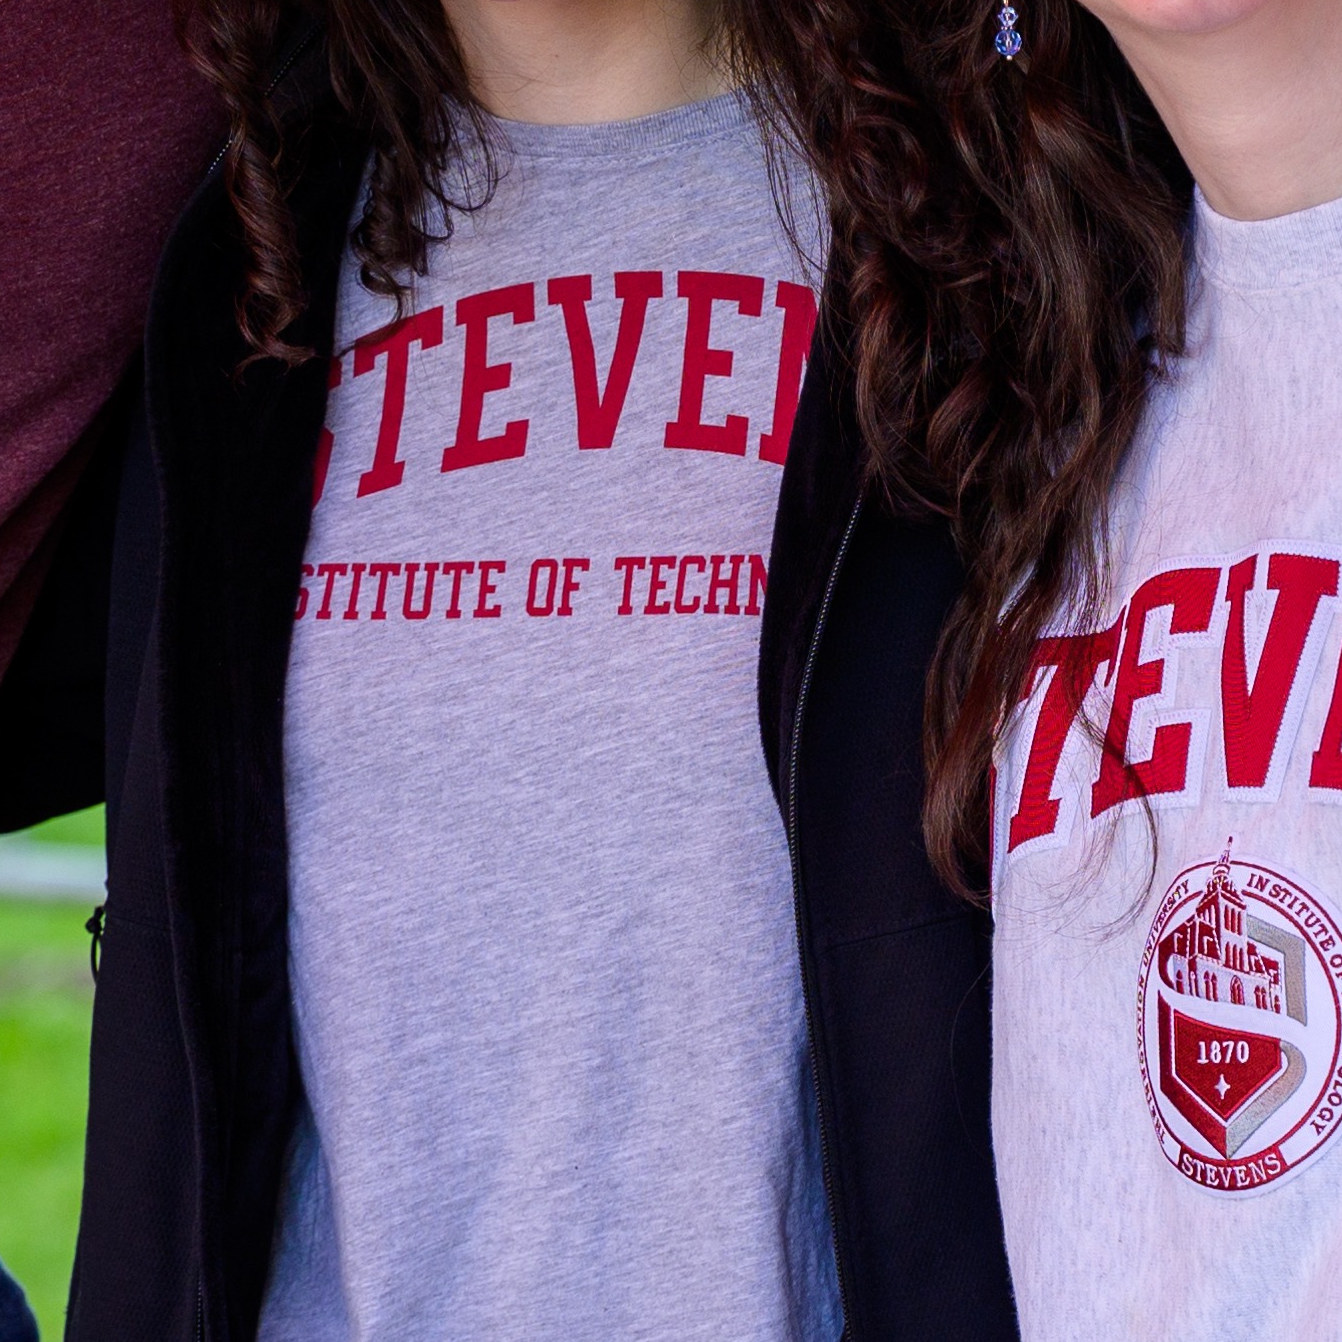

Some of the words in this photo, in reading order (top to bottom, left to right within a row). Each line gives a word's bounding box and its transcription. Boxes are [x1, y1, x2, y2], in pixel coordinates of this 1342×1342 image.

[312, 270, 819, 511] TEVE
[525, 557, 590, 617] OF
[1246, 872, 1336, 952] INSTITUTE
[1196, 1040, 1250, 1064] 1870
[1181, 1153, 1281, 1188] STEVENS
